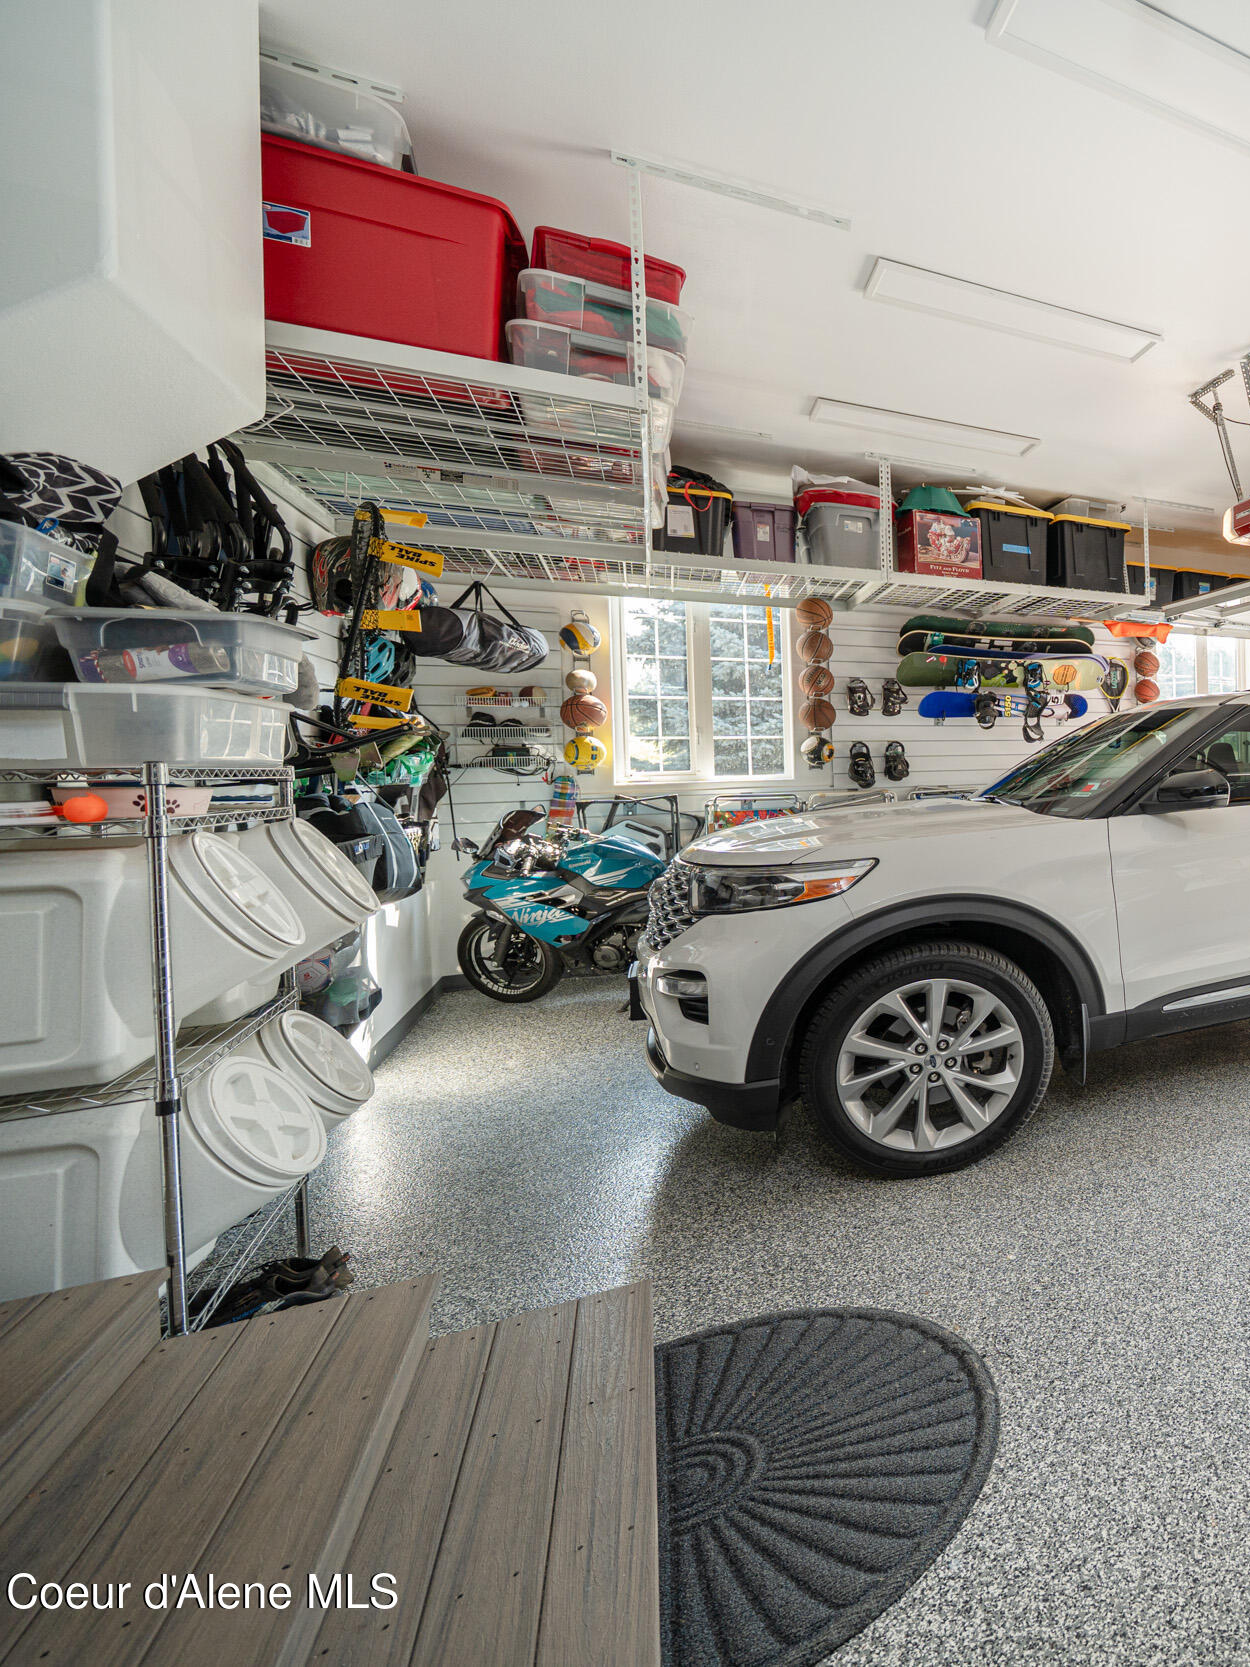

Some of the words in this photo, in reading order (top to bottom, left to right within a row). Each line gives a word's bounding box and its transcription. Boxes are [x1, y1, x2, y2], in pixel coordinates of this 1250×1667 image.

[388, 544, 423, 558] BALL
[394, 552, 437, 567] SPIKE
[353, 685, 388, 697] BALL
[359, 692, 402, 706] SPIKE
[1004, 695, 1012, 717] 5150
[512, 905, 572, 927] Ninja
